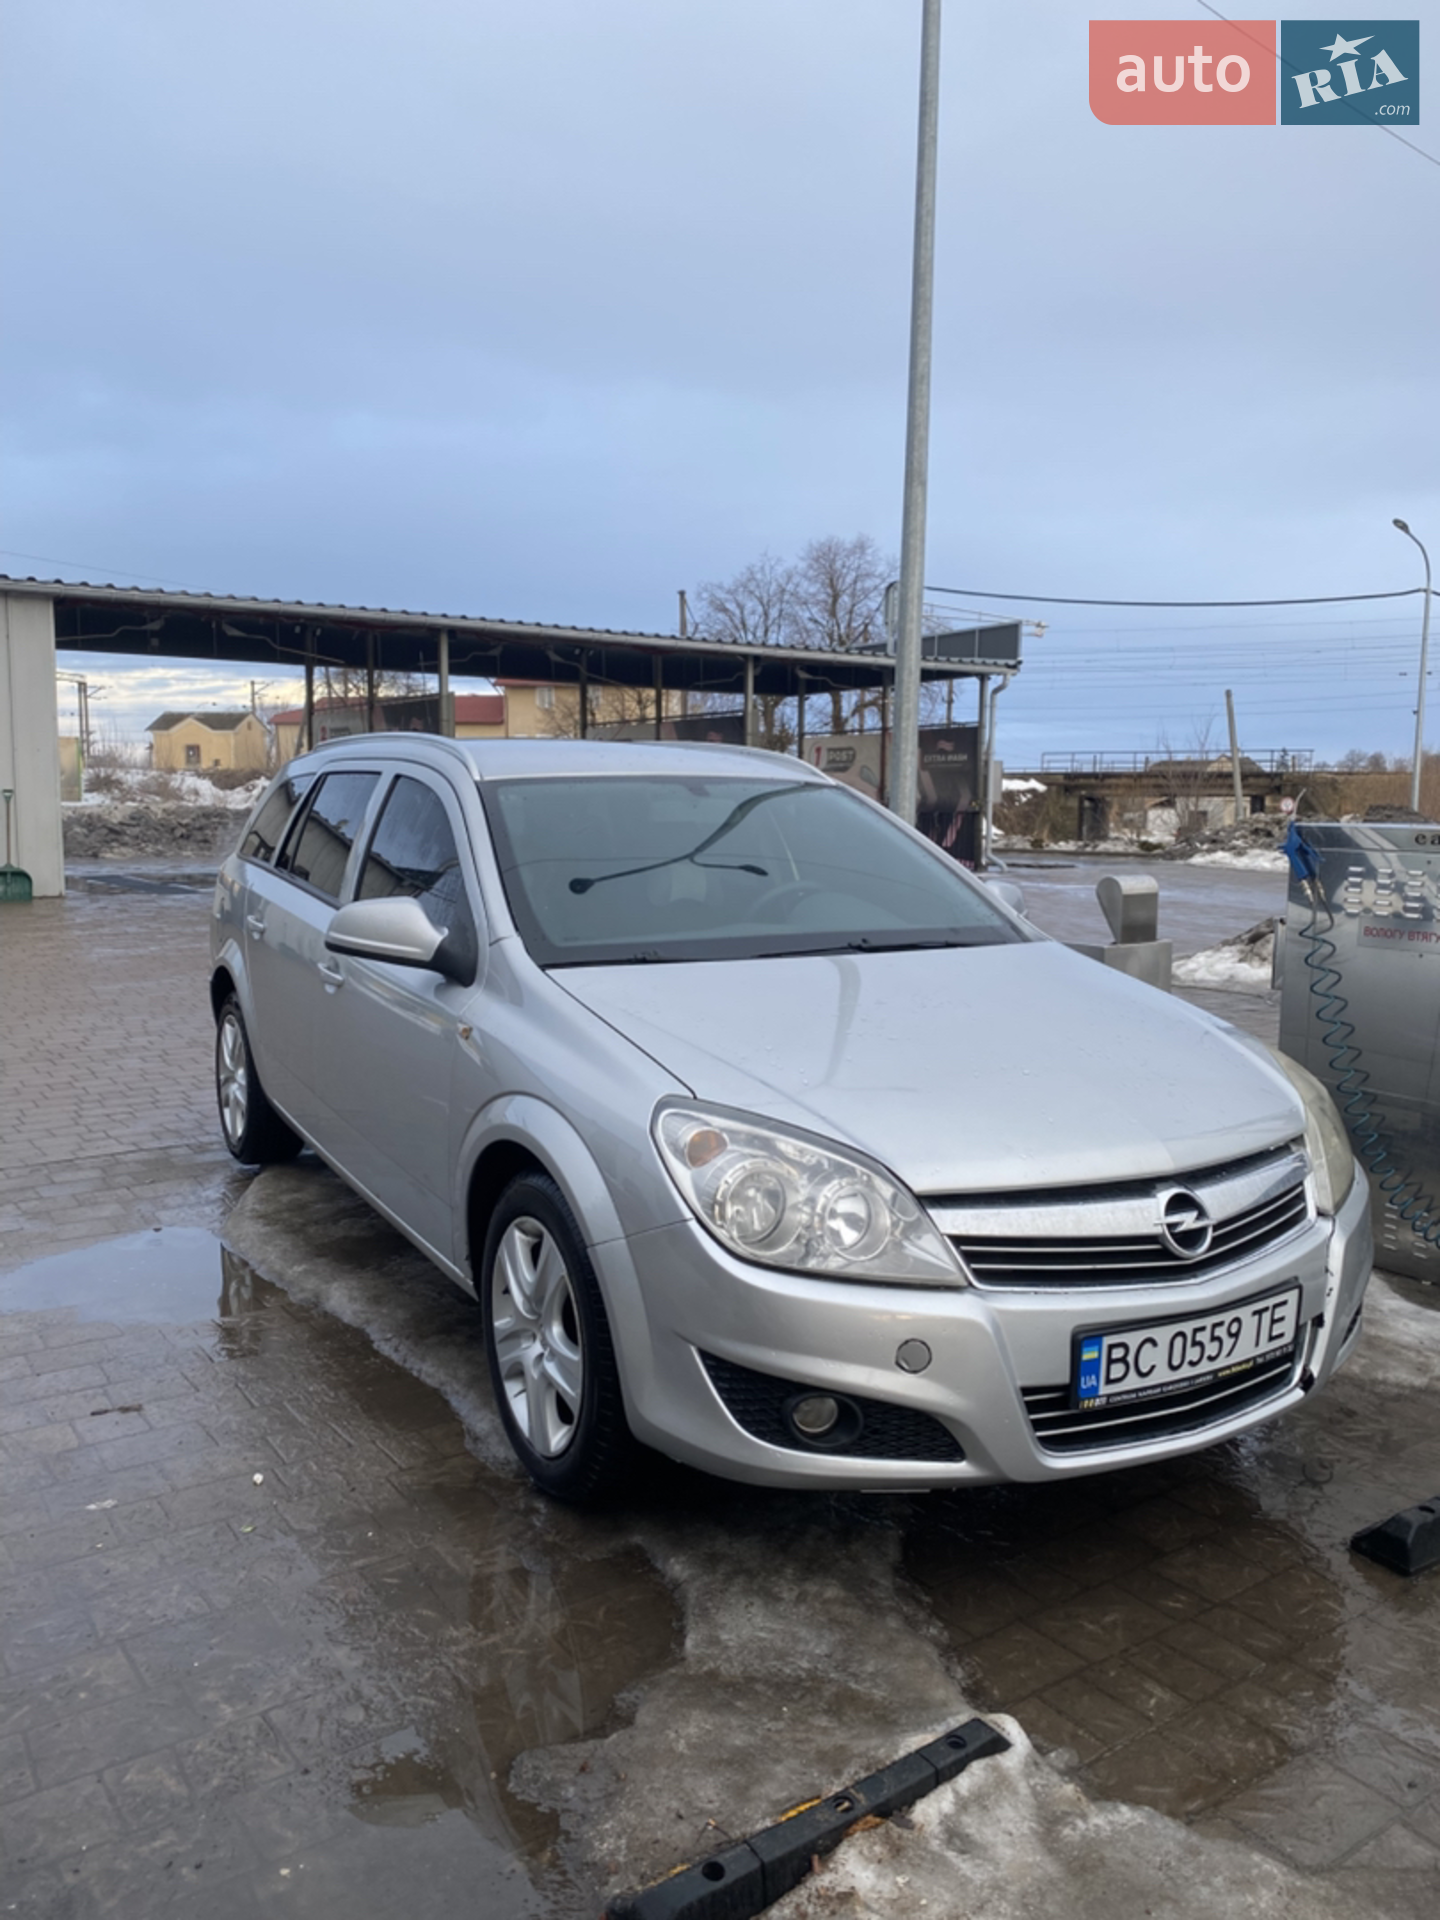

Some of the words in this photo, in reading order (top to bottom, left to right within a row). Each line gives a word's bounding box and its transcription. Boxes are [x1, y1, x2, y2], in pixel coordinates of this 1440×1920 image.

[1363, 925, 1405, 940] ВОЛОГУ
[1104, 1336, 1159, 1385] BC
[1167, 1316, 1242, 1372] 0559
[1251, 1299, 1289, 1348] TE
[1080, 1373, 1098, 1390] UA
